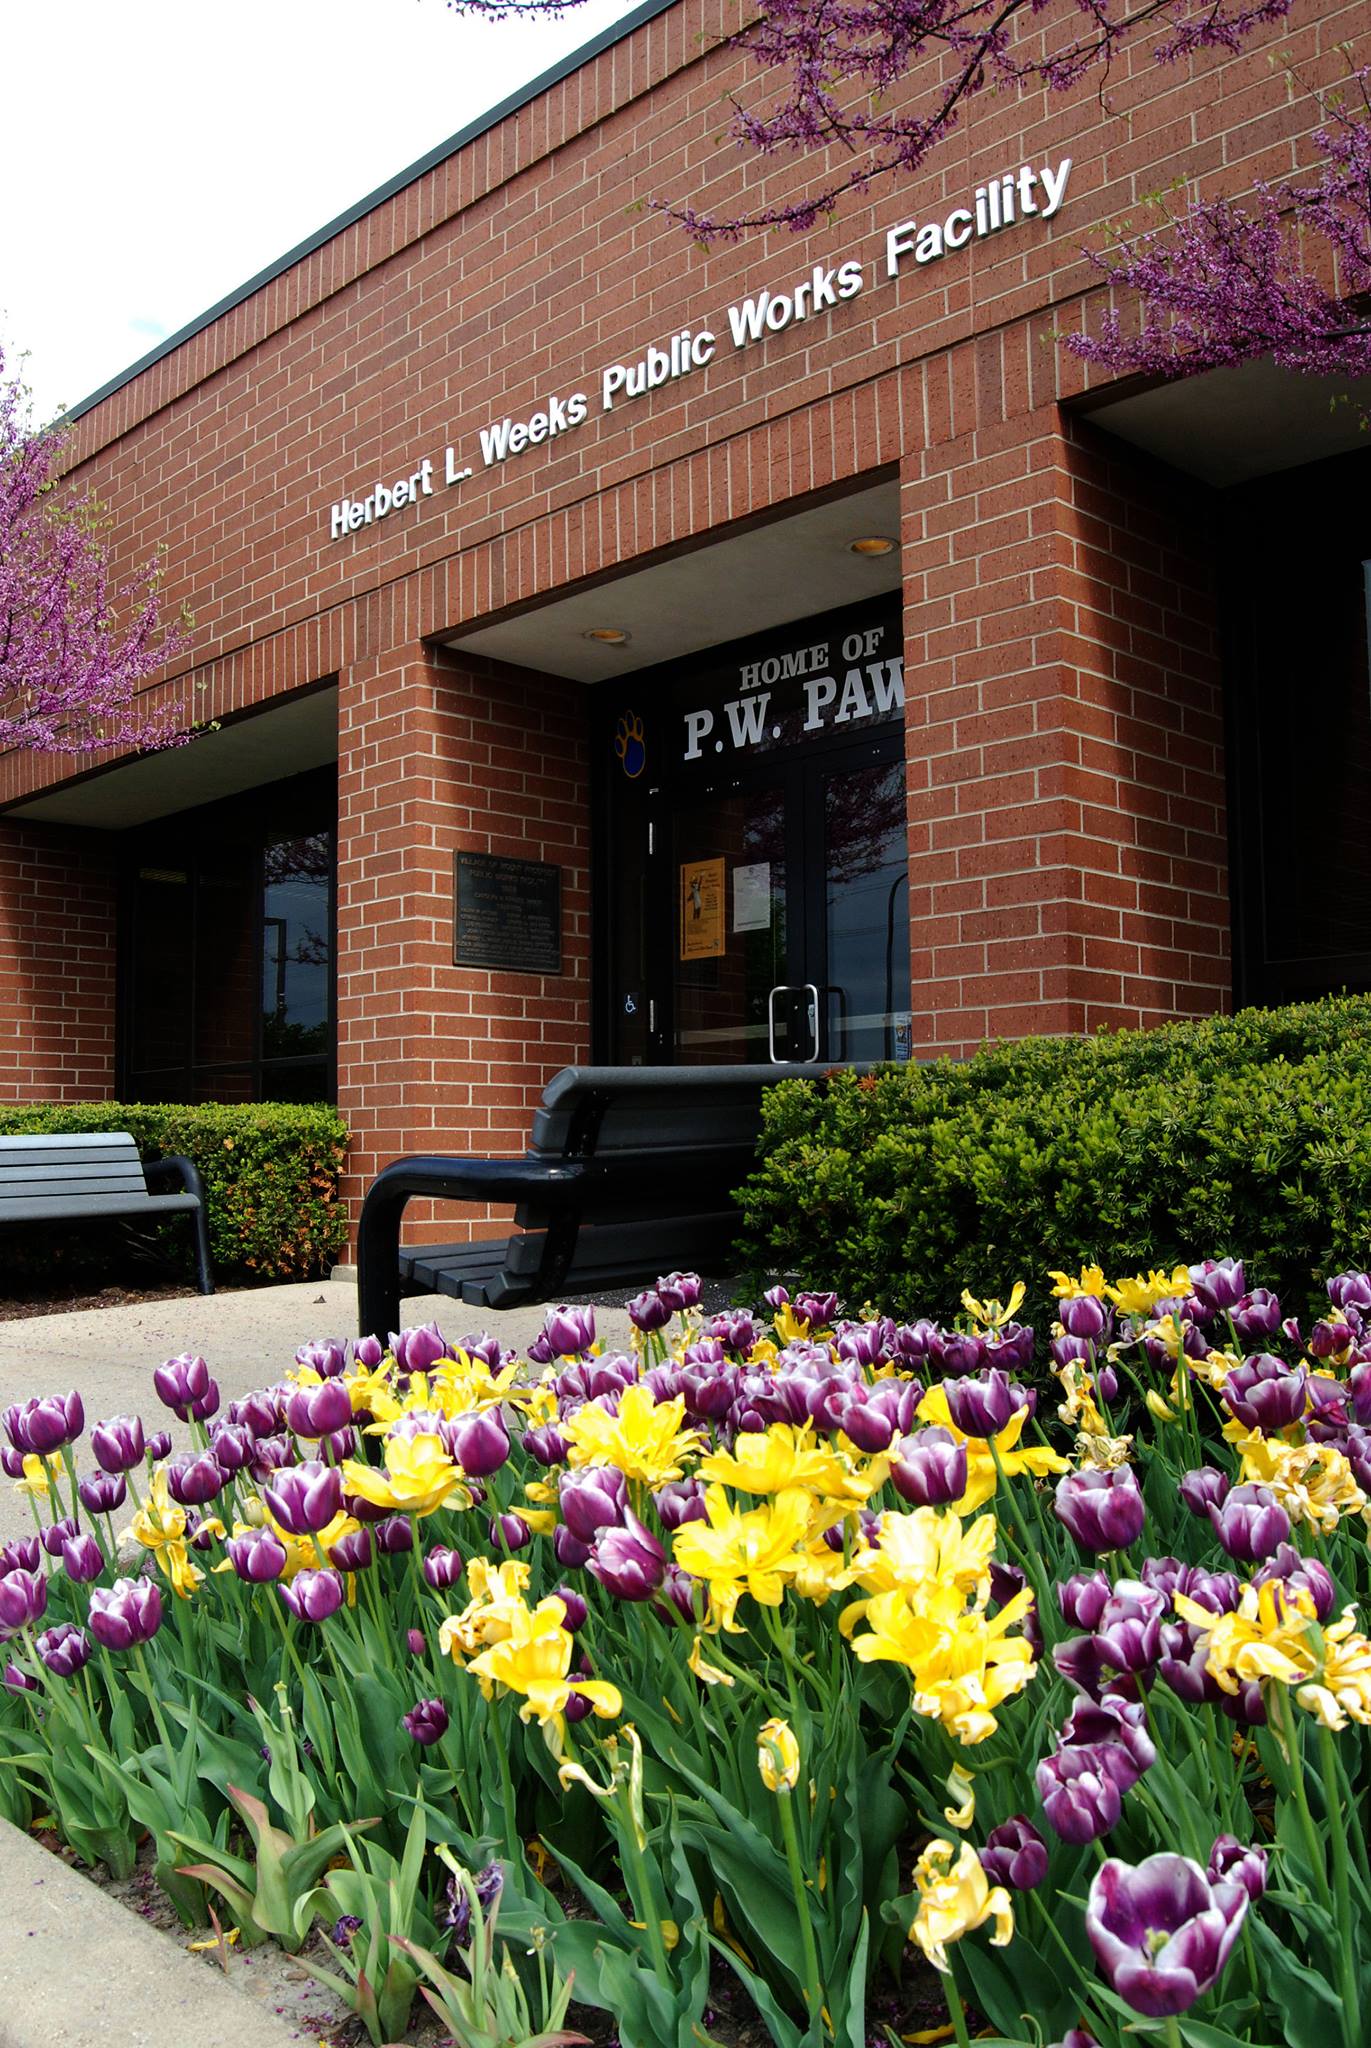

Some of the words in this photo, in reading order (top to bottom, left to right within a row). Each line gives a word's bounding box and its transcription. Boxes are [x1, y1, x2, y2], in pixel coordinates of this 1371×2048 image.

[331, 460, 433, 539] Herbert
[446, 447, 472, 485] L.
[480, 392, 587, 466] Weeks
[602, 329, 716, 410] Public
[728, 260, 862, 348] Works
[886, 159, 1071, 278] Facility
[739, 643, 829, 691] HOME
[842, 626, 884, 661] OF
[684, 692, 781, 760] P.W.
